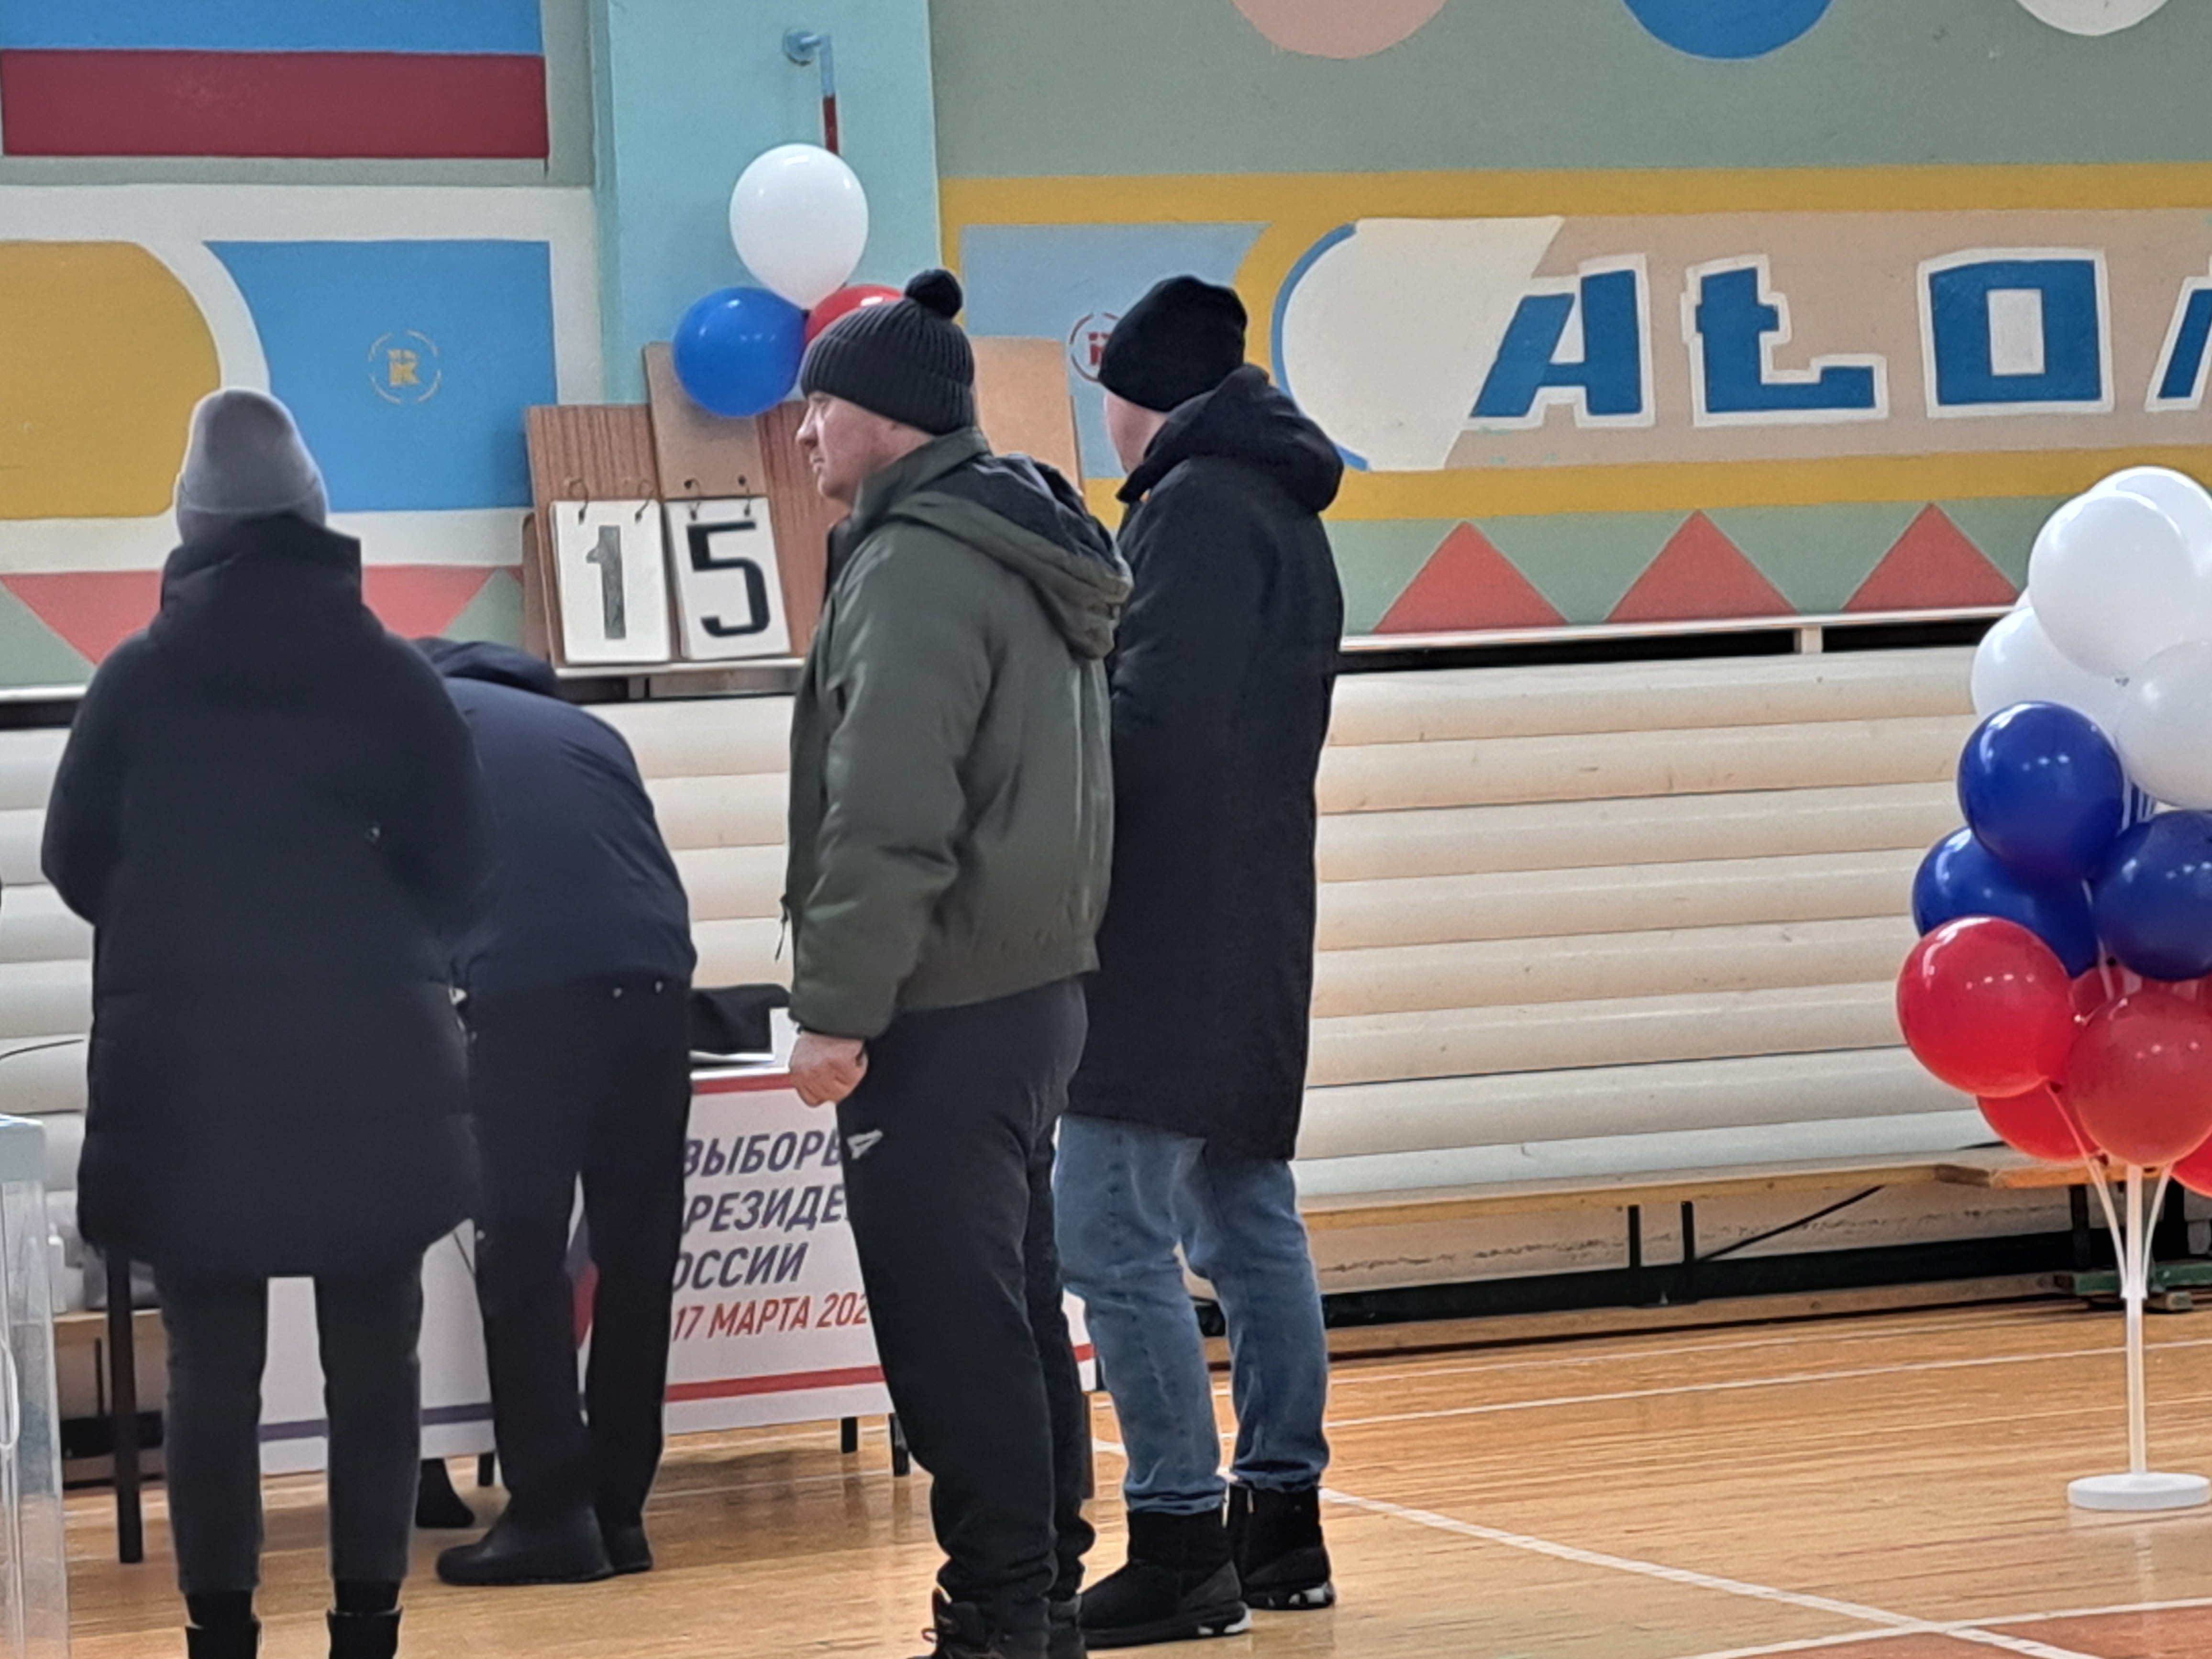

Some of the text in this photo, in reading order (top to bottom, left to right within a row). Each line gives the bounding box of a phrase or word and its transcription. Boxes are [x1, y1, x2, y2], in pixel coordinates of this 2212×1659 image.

[682, 1184, 846, 1234] РЕЗИДЕ
[673, 1242, 809, 1291] ОССИИ
[674, 1292, 867, 1341] 17 МАРТА 202
